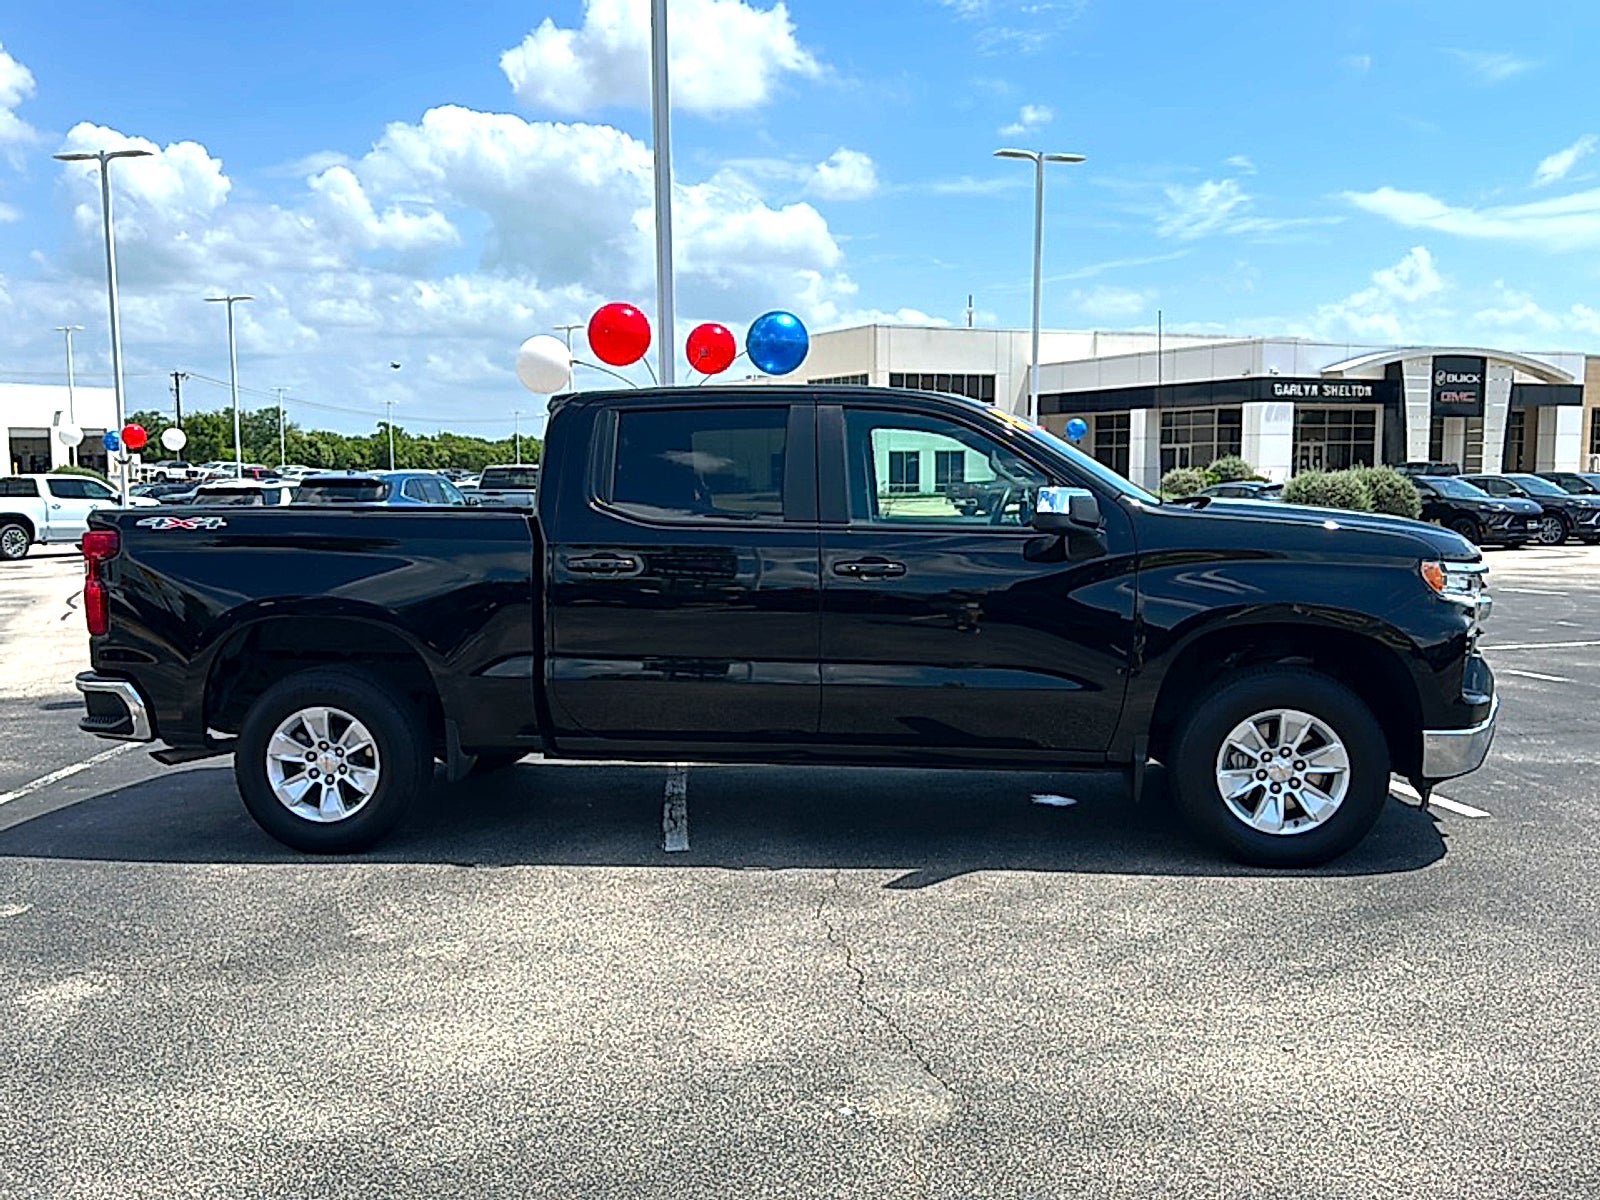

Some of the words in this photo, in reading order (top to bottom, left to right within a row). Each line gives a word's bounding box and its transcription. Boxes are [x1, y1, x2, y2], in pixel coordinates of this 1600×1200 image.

[1446, 373, 1481, 384] BUICK
[1273, 384, 1319, 397] GARLYN
[1322, 385, 1373, 397] SHELTON
[1440, 391, 1476, 402] GMC
